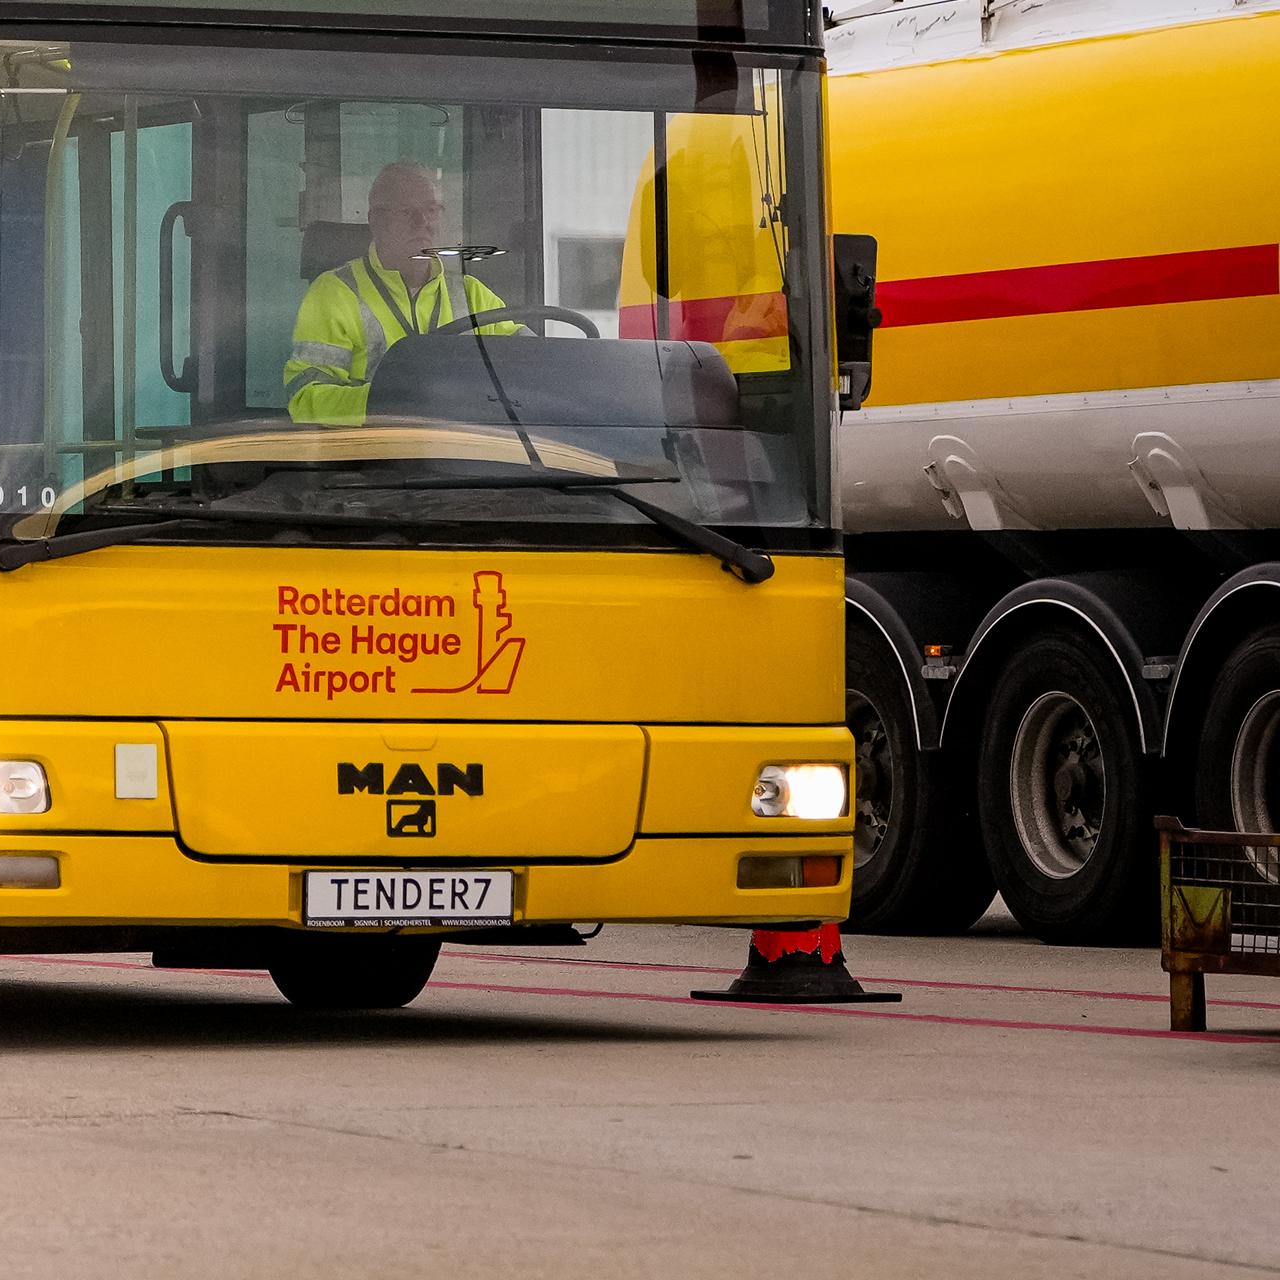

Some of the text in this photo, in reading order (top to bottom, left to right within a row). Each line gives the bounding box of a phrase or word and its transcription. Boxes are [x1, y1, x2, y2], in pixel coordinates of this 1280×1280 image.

[278, 586, 455, 617] Rotterdam
[273, 624, 461, 663] The Hague
[275, 662, 396, 700] Airport
[337, 763, 483, 796] MAN
[330, 878, 492, 910] TENDER7
